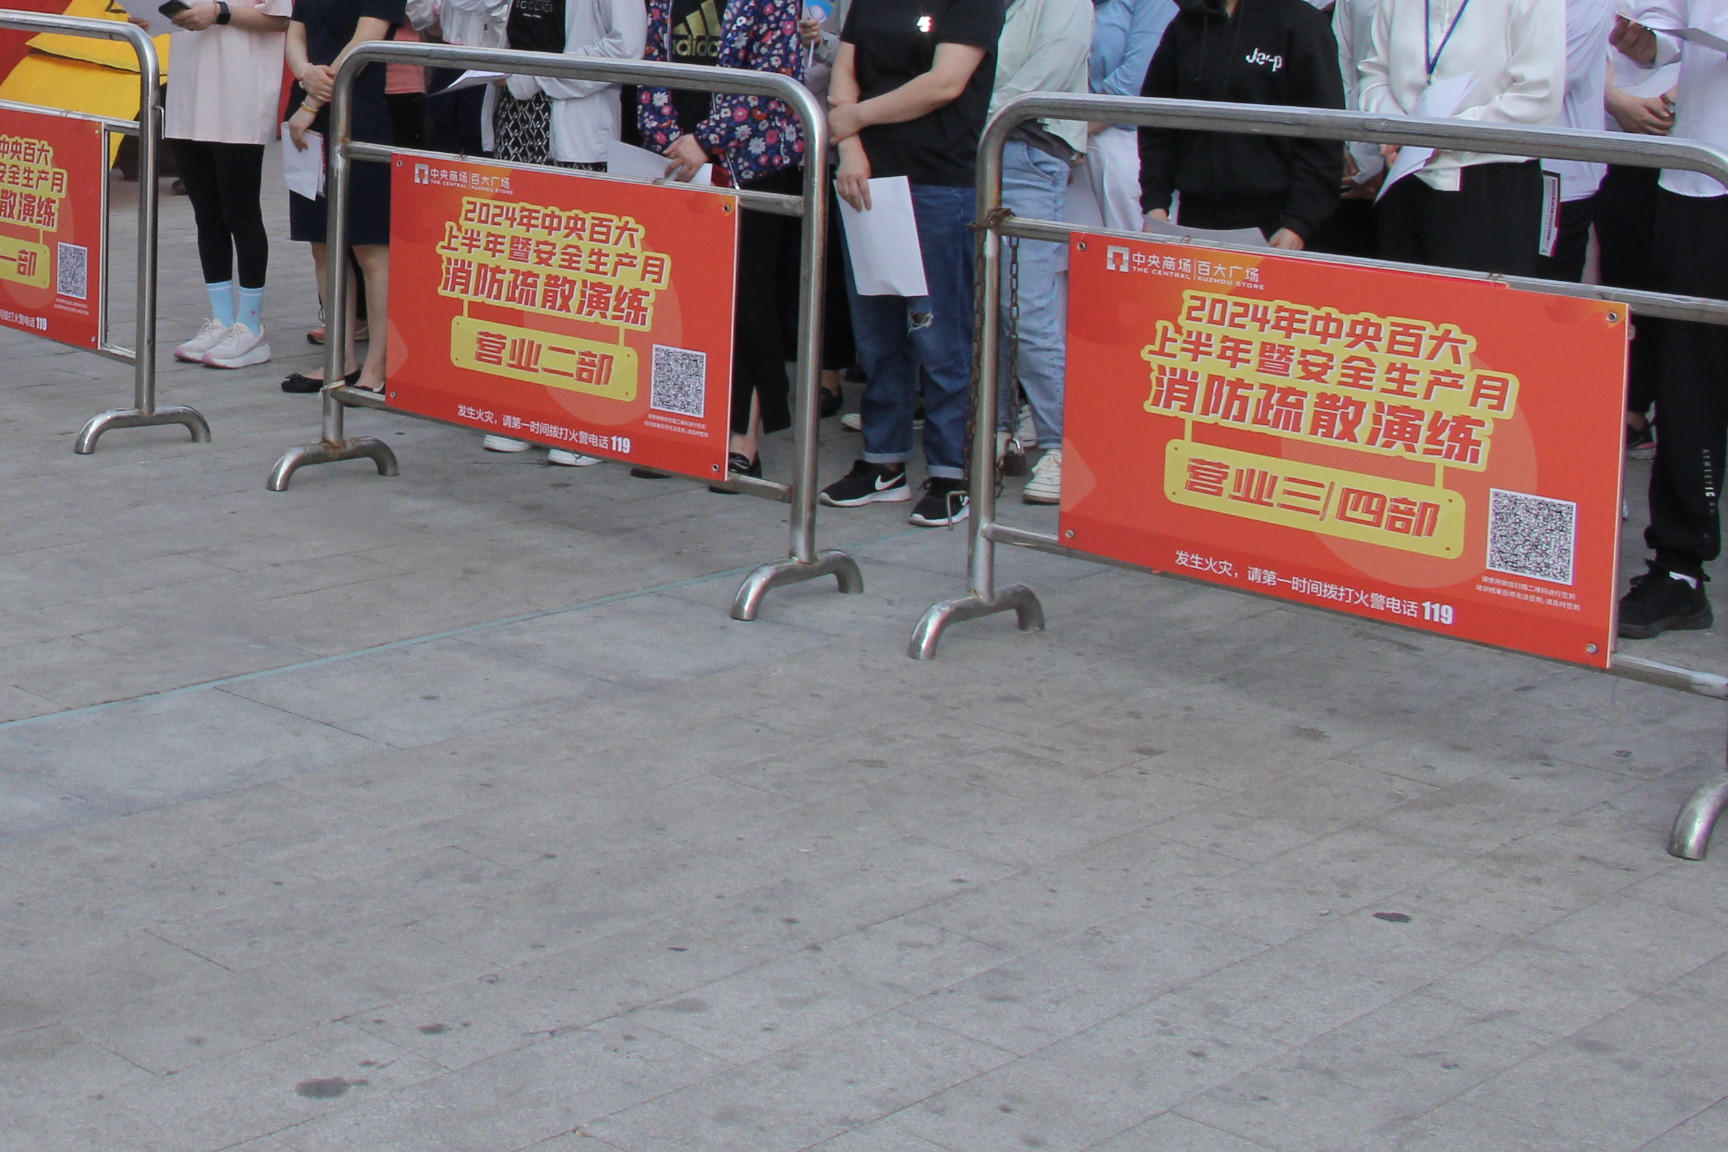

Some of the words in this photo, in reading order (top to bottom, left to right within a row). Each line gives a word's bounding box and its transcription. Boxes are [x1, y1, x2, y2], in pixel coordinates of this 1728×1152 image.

[672, 35, 722, 56] dida
[430, 168, 468, 184] 中央商场
[472, 173, 510, 189] 百大广场
[464, 200, 640, 249] 2024年中央百大
[440, 224, 667, 285] 上半年暨安全生产月
[1132, 252, 1192, 273] 中央商场
[1197, 260, 1259, 283] 百大广场
[1132, 266, 1149, 274] THE
[1152, 269, 1192, 280] CENTRAL
[1197, 276, 1233, 286] XUZHOU
[1236, 281, 1265, 291] STORE
[442, 256, 651, 327] 消防疏散演练
[36, 316, 48, 331] 119
[1185, 294, 1469, 367] 2024年中央百大
[474, 330, 615, 386] 营业二部
[1146, 325, 1512, 413] 上半年暨安全生产月
[457, 403, 609, 450] 发生火灾，请第一时间拨打火警电话
[610, 435, 631, 454] 119
[1150, 364, 1488, 465] 消防疏散演练
[1184, 457, 1441, 538] 营业三/四部
[1174, 549, 1419, 619] 发生火灾，请第一时间拨打火警电话
[1421, 600, 1454, 626] 119
